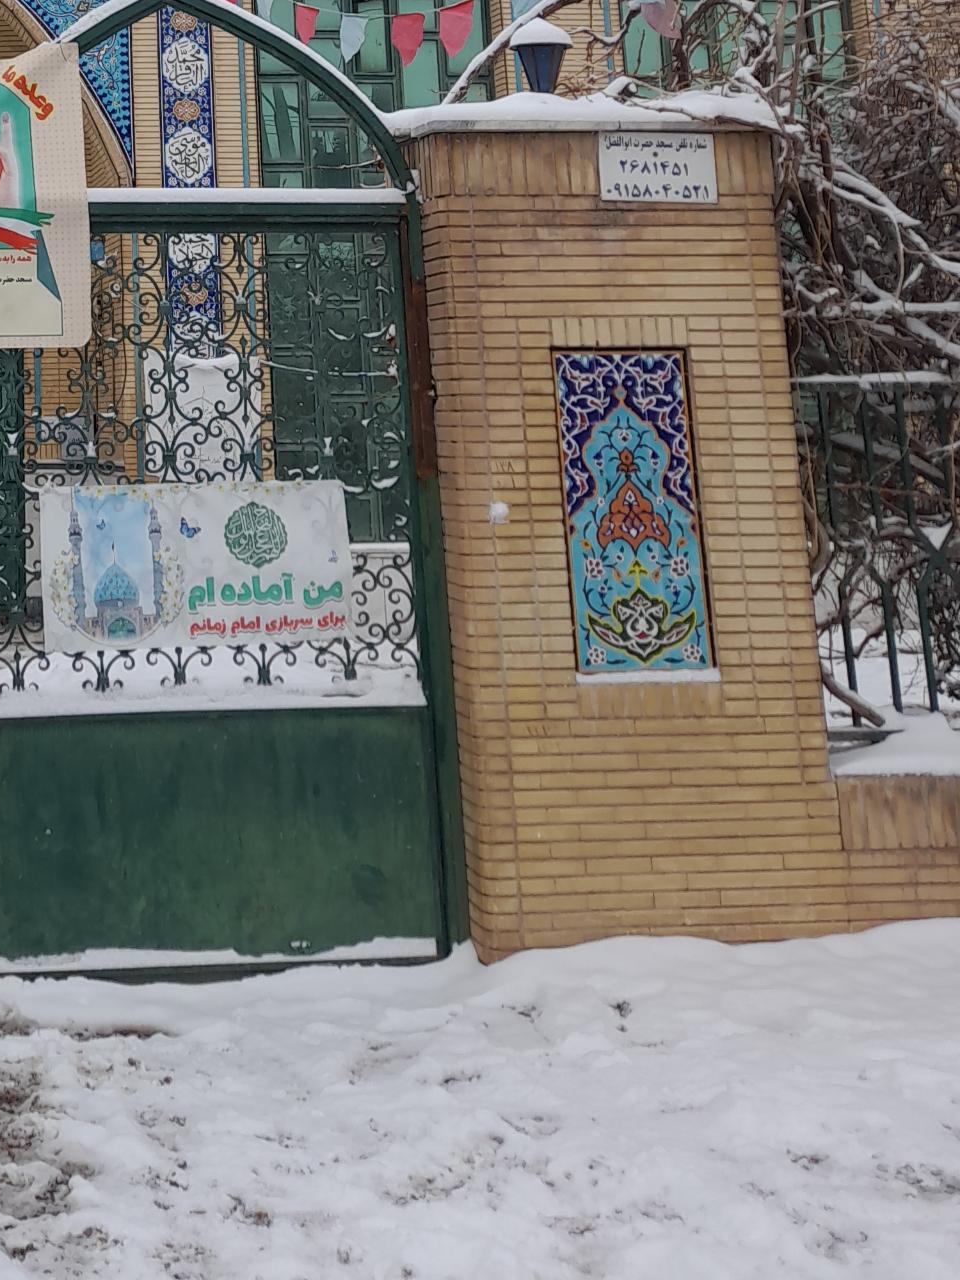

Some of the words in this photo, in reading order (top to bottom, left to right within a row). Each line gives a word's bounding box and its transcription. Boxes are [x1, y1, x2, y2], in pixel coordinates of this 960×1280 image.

[2, 65, 17, 83] ما
[14, 74, 54, 121] وعده
[634, 136, 654, 151] حضرت
[655, 138, 673, 152] مسجد
[689, 138, 708, 153] شماره
[16, 255, 32, 263] همه
[16, 276, 32, 285] مسجد
[188, 576, 215, 612] ام
[220, 572, 294, 604] آماده
[303, 580, 344, 608] من
[190, 618, 227, 636] زمانم
[231, 616, 261, 635] امام
[265, 615, 313, 633] سربازی
[317, 611, 346, 629] برای
